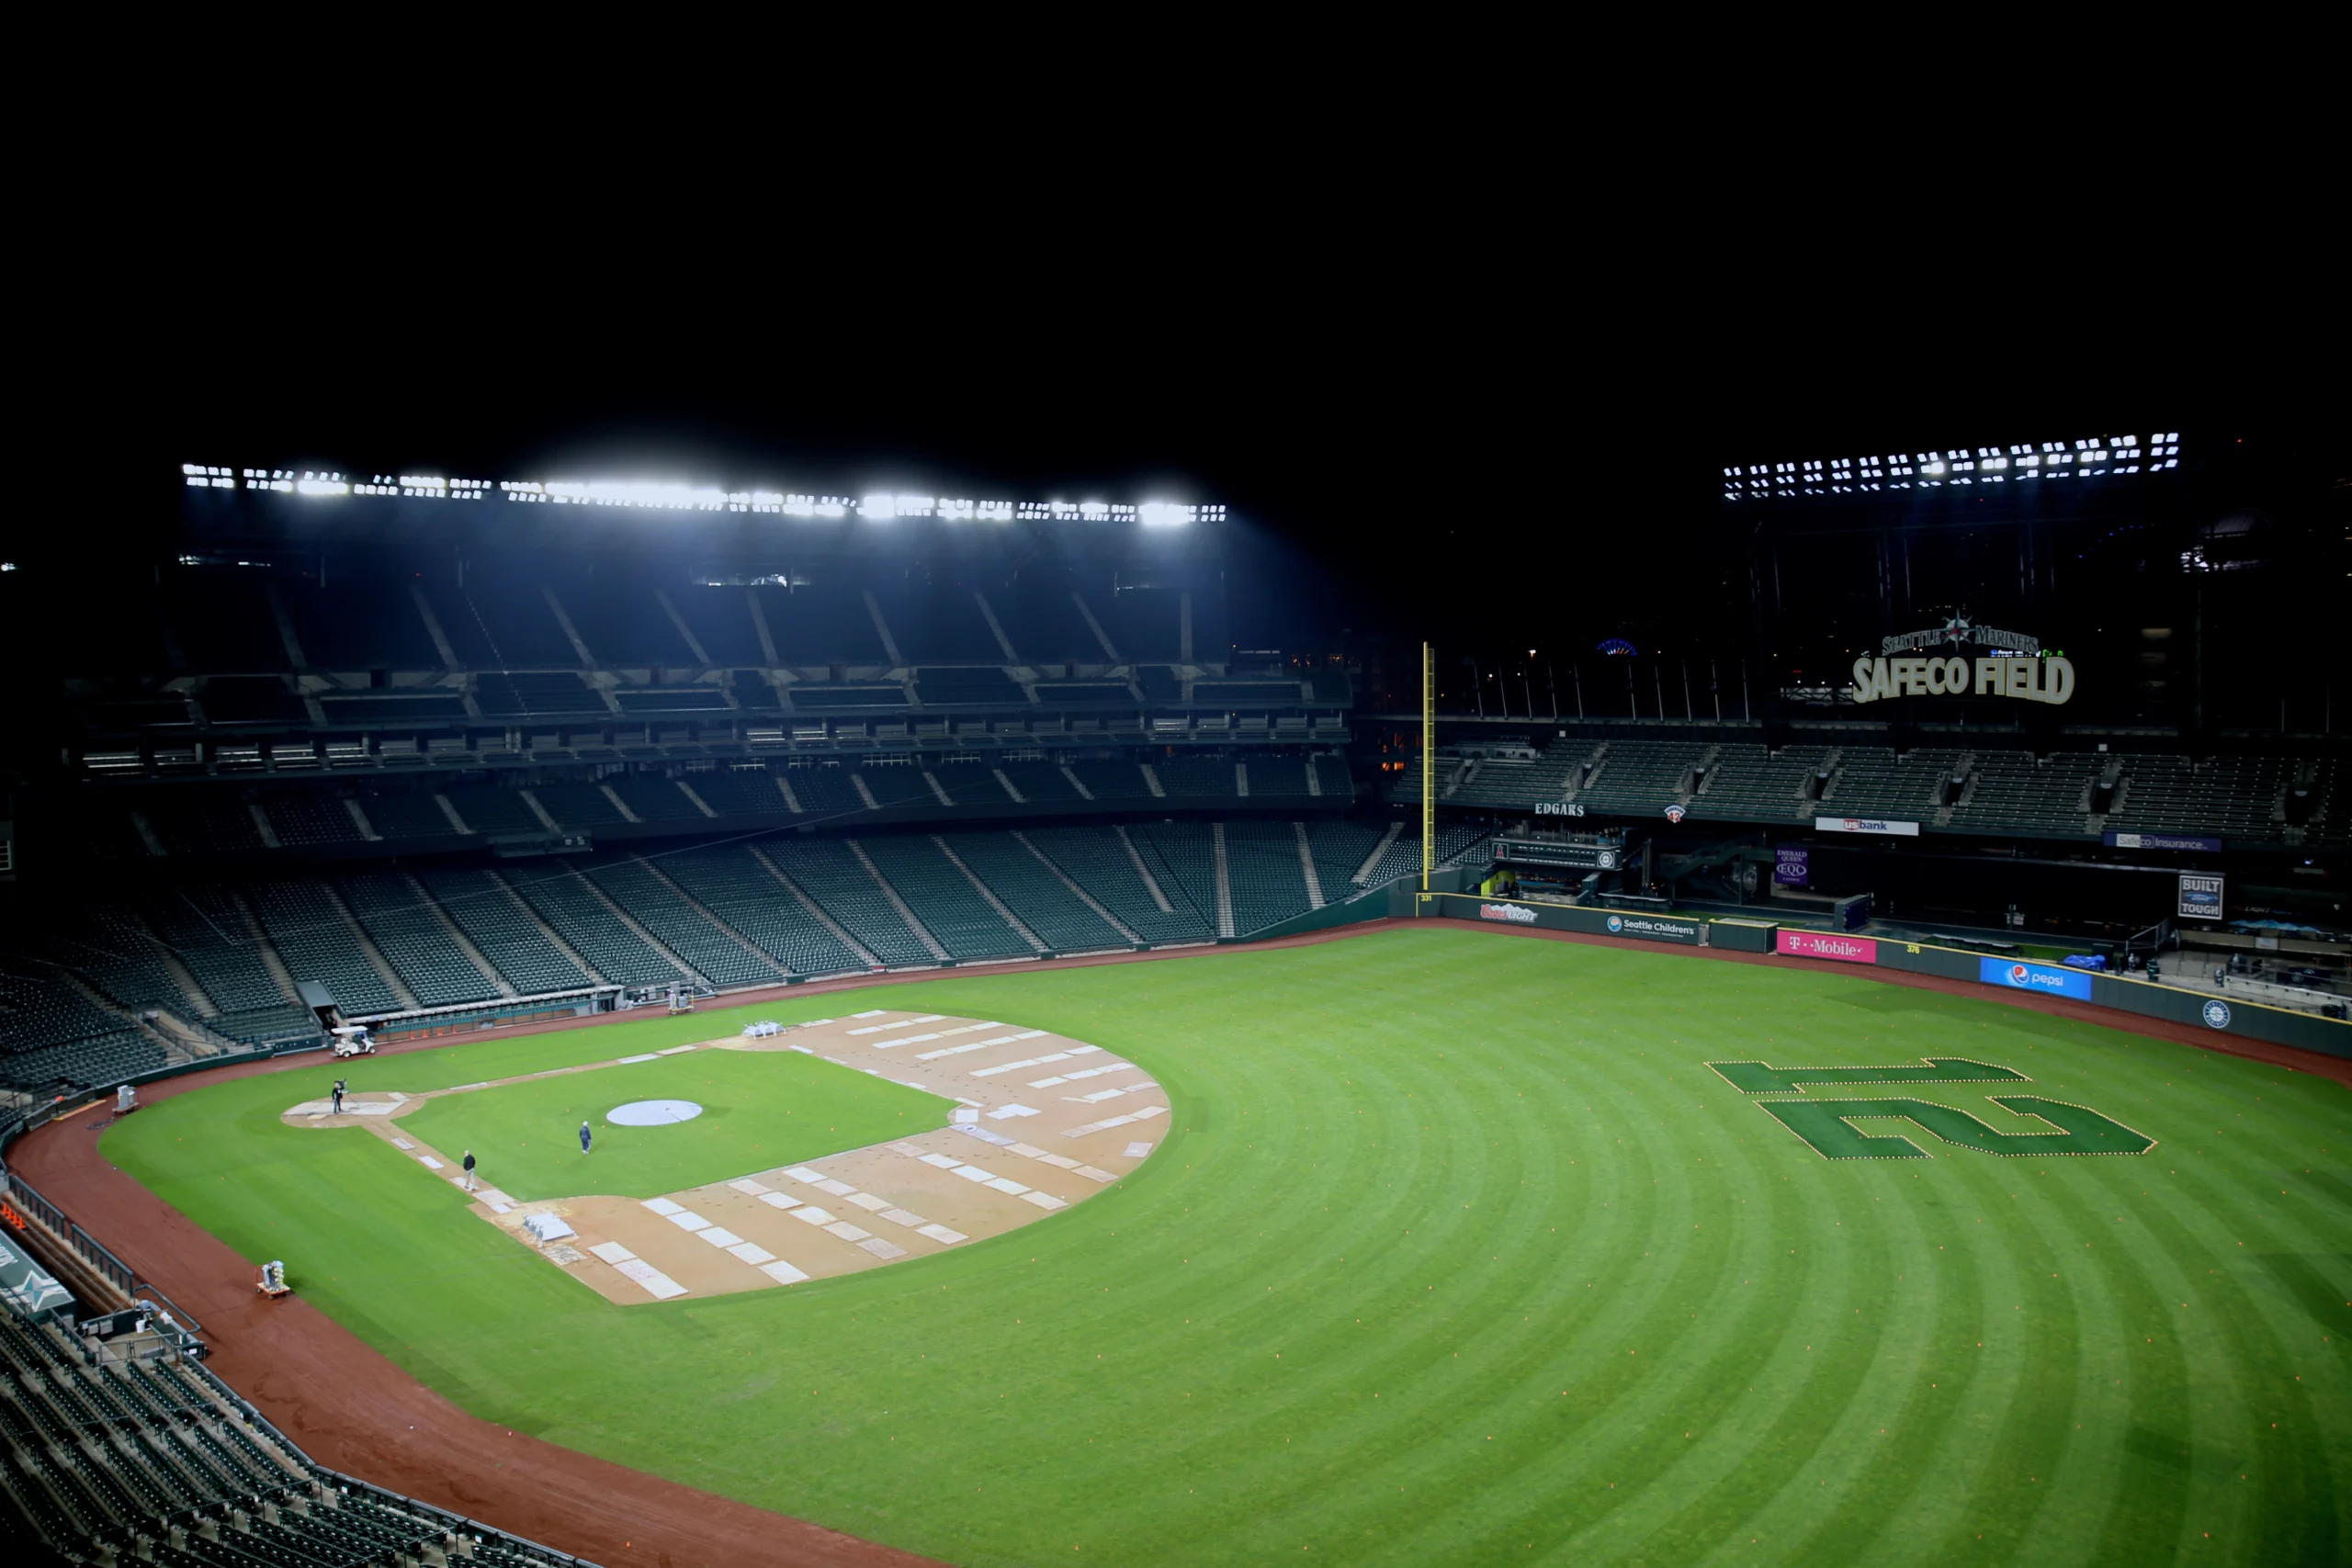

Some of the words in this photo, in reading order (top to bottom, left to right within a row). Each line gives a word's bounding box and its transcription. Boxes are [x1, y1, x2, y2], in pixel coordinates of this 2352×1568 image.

[1883, 629, 1942, 656] SEATTLE
[1975, 625, 2039, 654] MARINERS
[1852, 656, 1970, 704] SAFECO
[1975, 656, 2075, 705] FIELD
[1668, 812, 1681, 822] 42
[2154, 837, 2203, 849] Insurance
[2182, 879, 2220, 892] BUILT
[2181, 903, 2219, 915] TOUGH
[1507, 910, 1538, 922] LIGHT
[1623, 919, 1653, 930] Seattle
[1654, 922, 1694, 935] Children's
[1906, 944, 1920, 953] 376
[2031, 973, 2064, 987] pepsi
